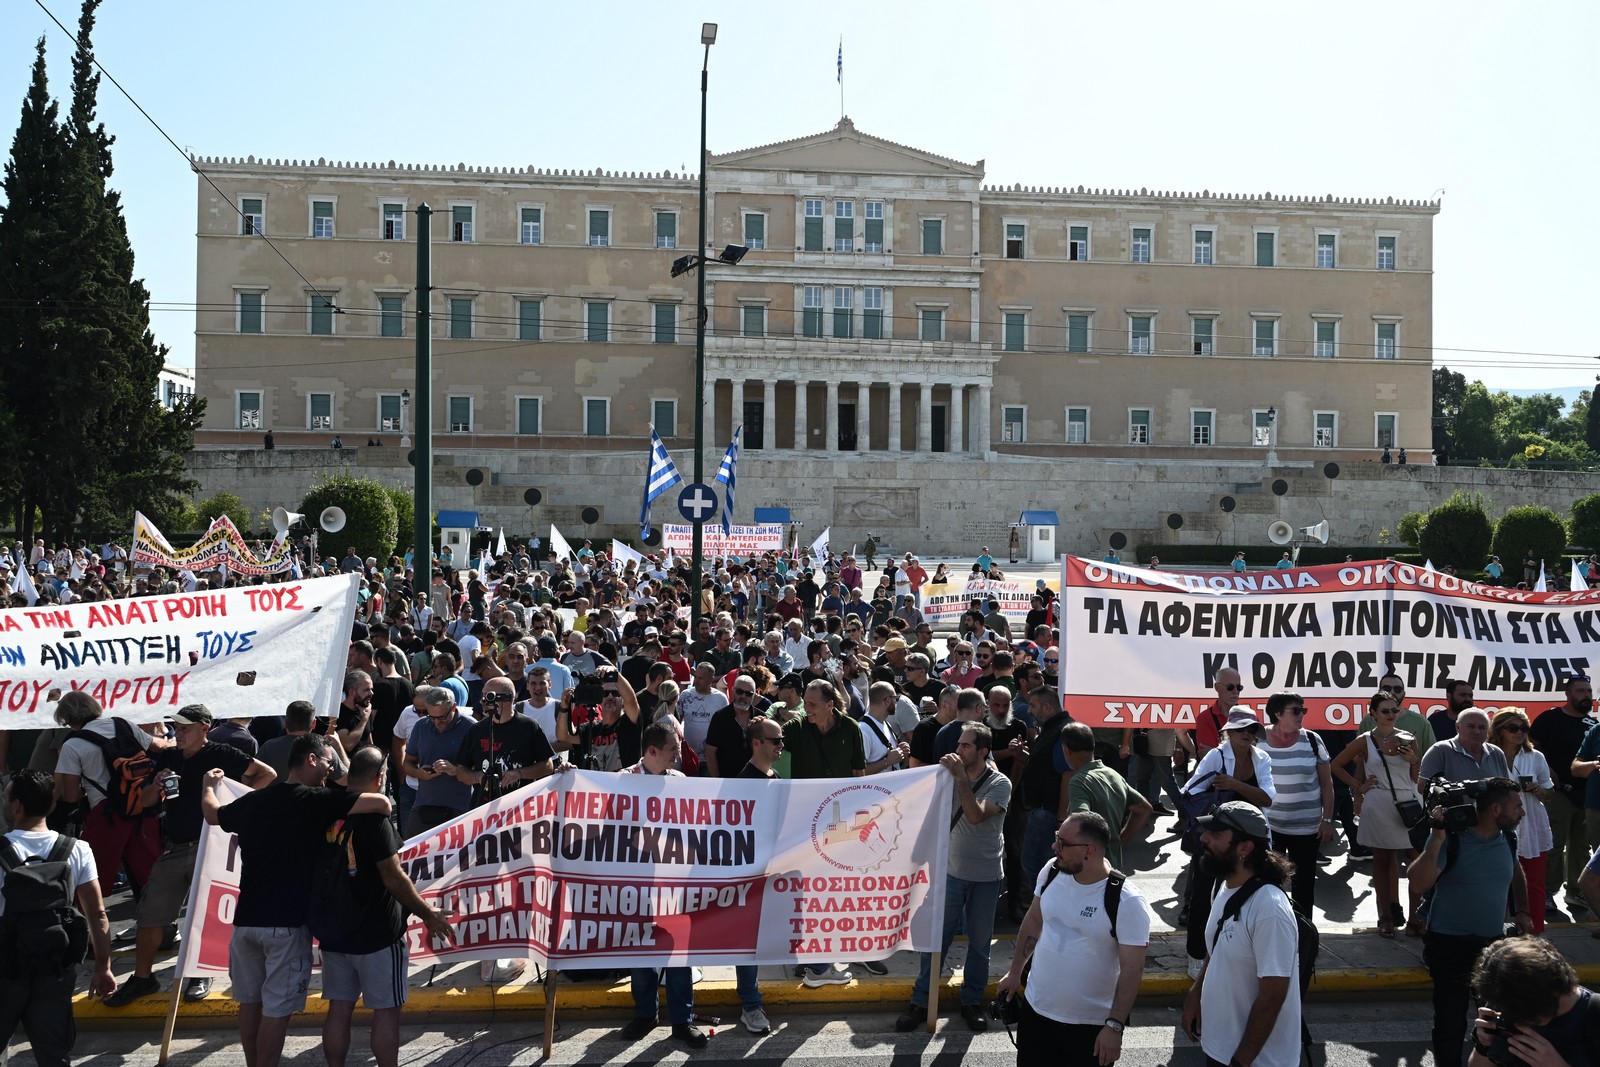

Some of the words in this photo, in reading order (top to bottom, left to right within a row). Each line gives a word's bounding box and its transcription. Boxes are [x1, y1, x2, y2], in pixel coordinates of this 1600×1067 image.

[670, 526, 693, 534] ΑΝΑΠΤ
[704, 526, 717, 534] ΣΑΣ
[136, 540, 164, 560] ΝΑΝΤΙΑ
[178, 550, 194, 558] ΚΑΙ
[930, 596, 944, 605] ΑΠΟ
[946, 595, 959, 603] ΤΗΝ
[1337, 564, 1534, 602] ΟΙΚΟΔΟΜΩΝ
[24, 610, 74, 629] ΤΗΝ
[88, 594, 226, 628] ΑΝΑΤΡΟΠΗ
[244, 585, 304, 612] ΤΟΥΣ
[1084, 597, 1128, 635] ΤΑ
[1138, 600, 1322, 638] ΑΦΕΝΤΙΚΑ
[1332, 600, 1503, 643] ΠΝΙΓΟΝΤΑΙ
[1507, 611, 1571, 644] ΣΤΑ
[41, 635, 181, 670] ΑΝΑΠΤΥΞΗ
[196, 630, 257, 660] ΤΟΥΣ
[1252, 652, 1276, 689] Ο
[1284, 650, 1378, 688] ΛΑΟΣ
[1385, 651, 1456, 689] ΣΤΙΣ
[435, 825, 465, 850] ΤΗ
[563, 791, 640, 822] ΜΕΧΡΙ
[646, 796, 756, 826] ΘΑΝΑΤΟΥ
[813, 797, 832, 823] ΓΑΛΑΚΤΟΣ
[831, 785, 861, 798] ΤΡΟΦΙΜΩΝ
[874, 786, 892, 795] ΠΟΤΩΝ
[532, 820, 755, 866] ΒΙΟΜΗΧΑΝΩΝ
[518, 876, 558, 911] ΤΟΥ
[564, 882, 754, 917] ΠΕΝΘΗΜΕΡΟΥ
[773, 870, 928, 893] ΟΜΟΣΠΟΝΔΙΑ
[793, 892, 911, 913] ΓΑΛΑΚΤΟΣ
[558, 920, 656, 951] ΑΡΓΙΑΣ
[789, 910, 910, 934] ΤΡΟΦΙΜΩΝ
[789, 938, 834, 954] ΚΑΙ
[840, 926, 909, 953] ΠΟΤΩΝ
